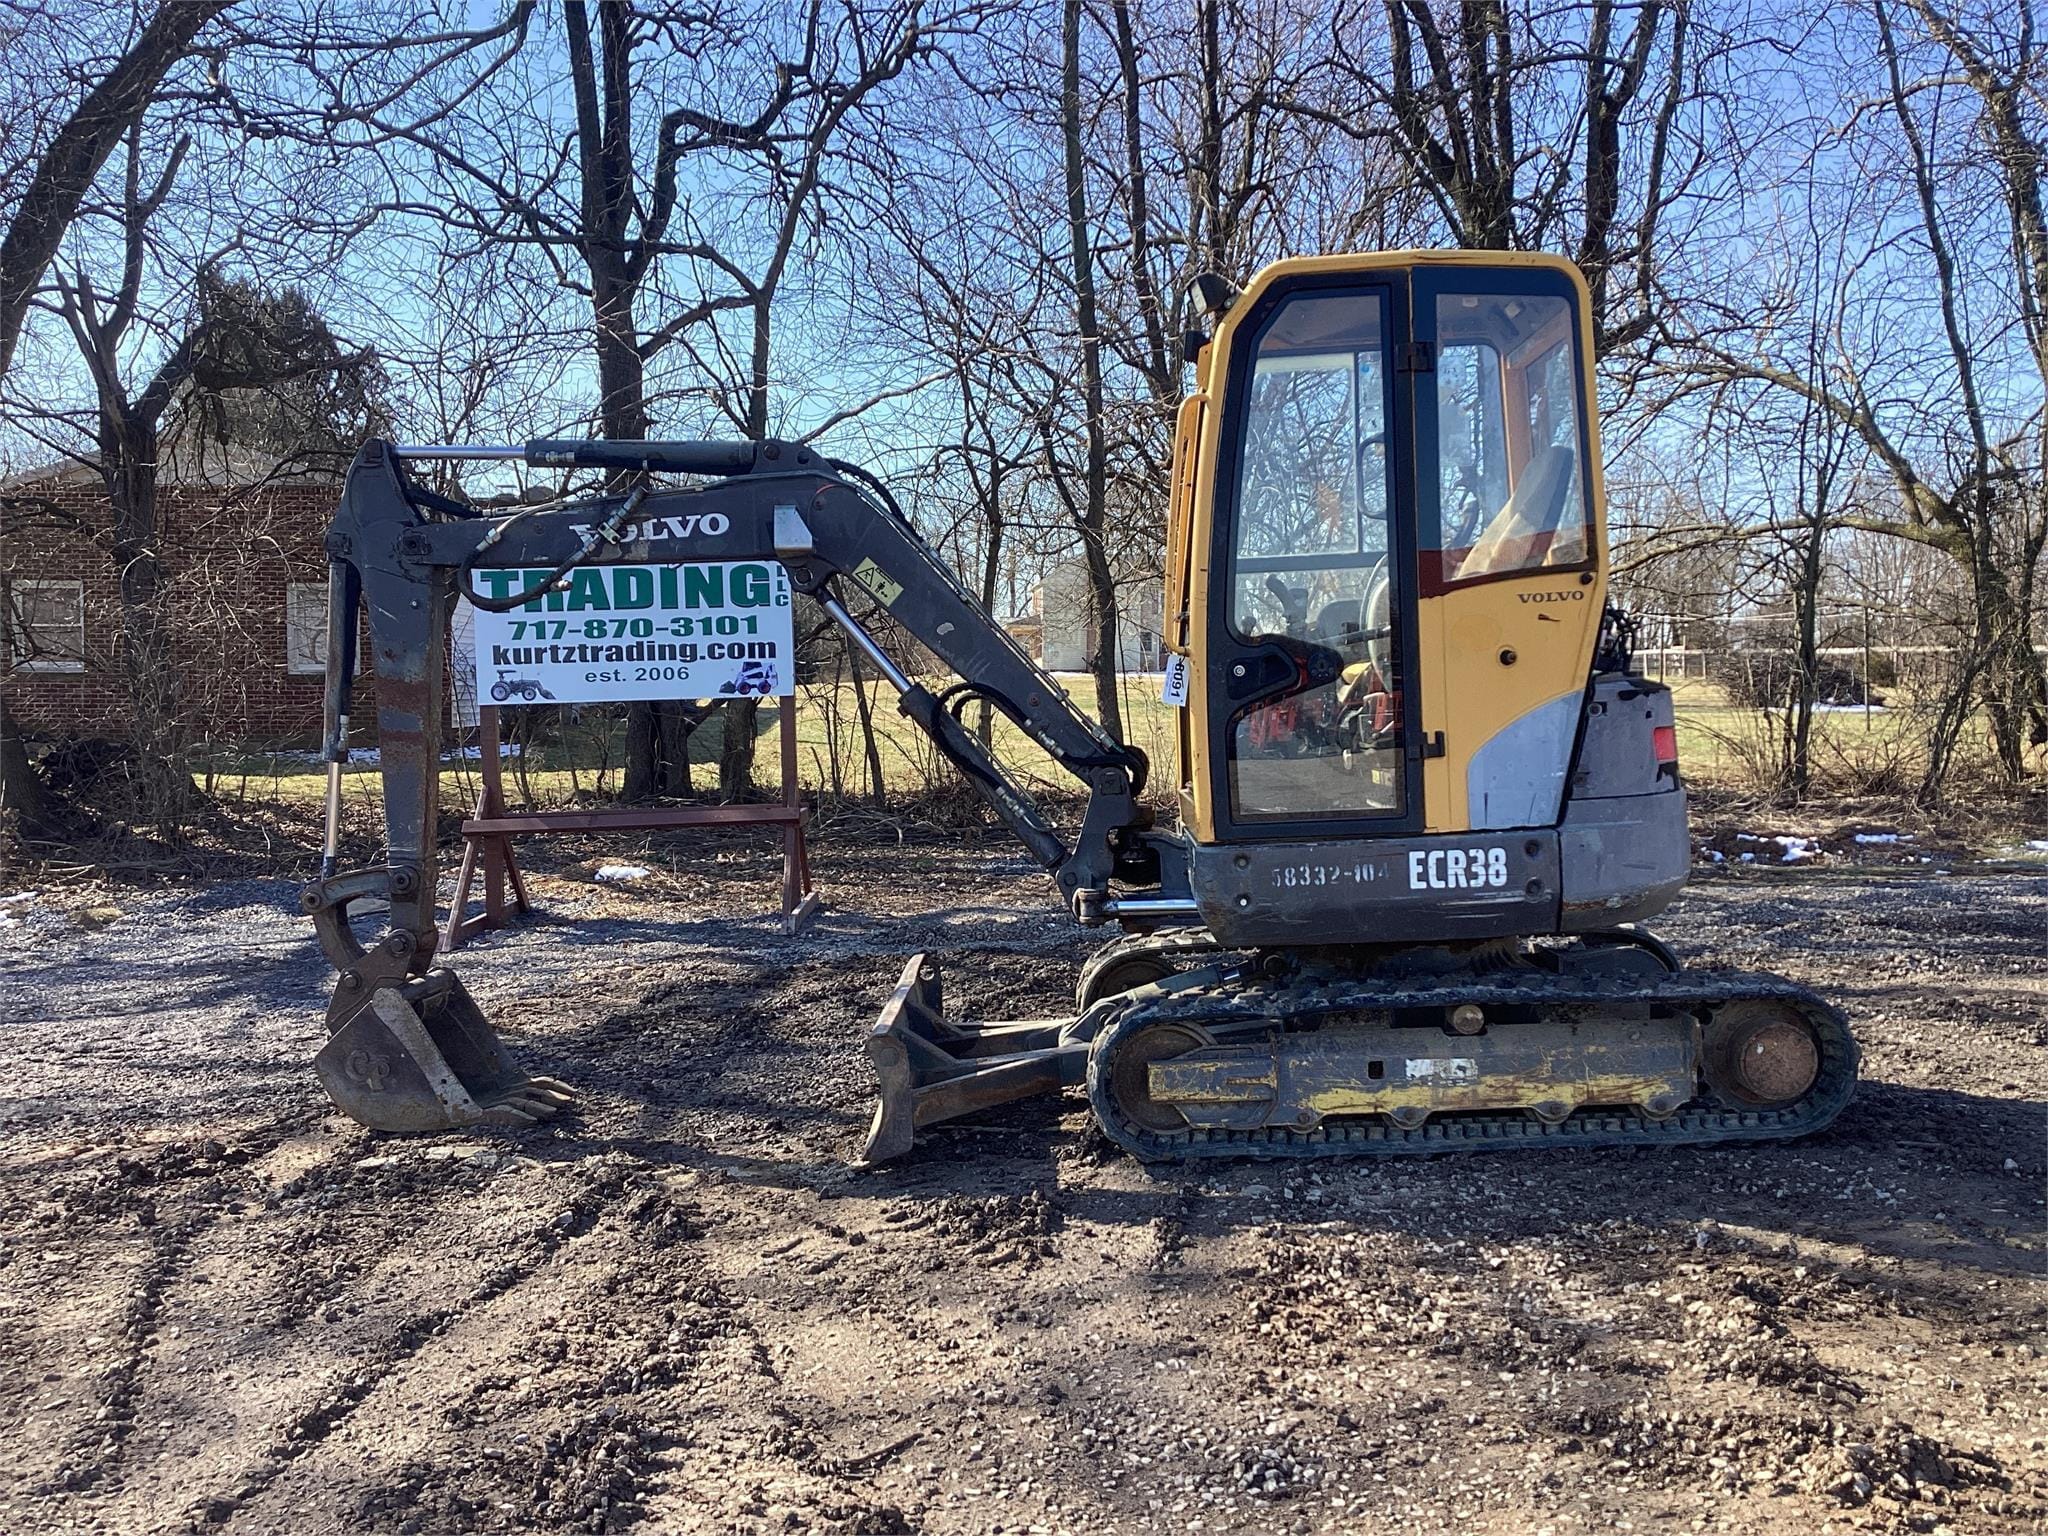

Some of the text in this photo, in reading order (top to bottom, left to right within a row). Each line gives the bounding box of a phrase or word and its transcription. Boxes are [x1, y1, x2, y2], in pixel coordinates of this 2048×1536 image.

[480, 564, 770, 613] TRADING
[1517, 591, 1584, 603] VOLVO
[507, 615, 758, 640] 717-870-3101
[492, 641, 777, 666] kurtztrading.com
[585, 667, 689, 682] est. 2006
[1409, 848, 1507, 889] ECR38
